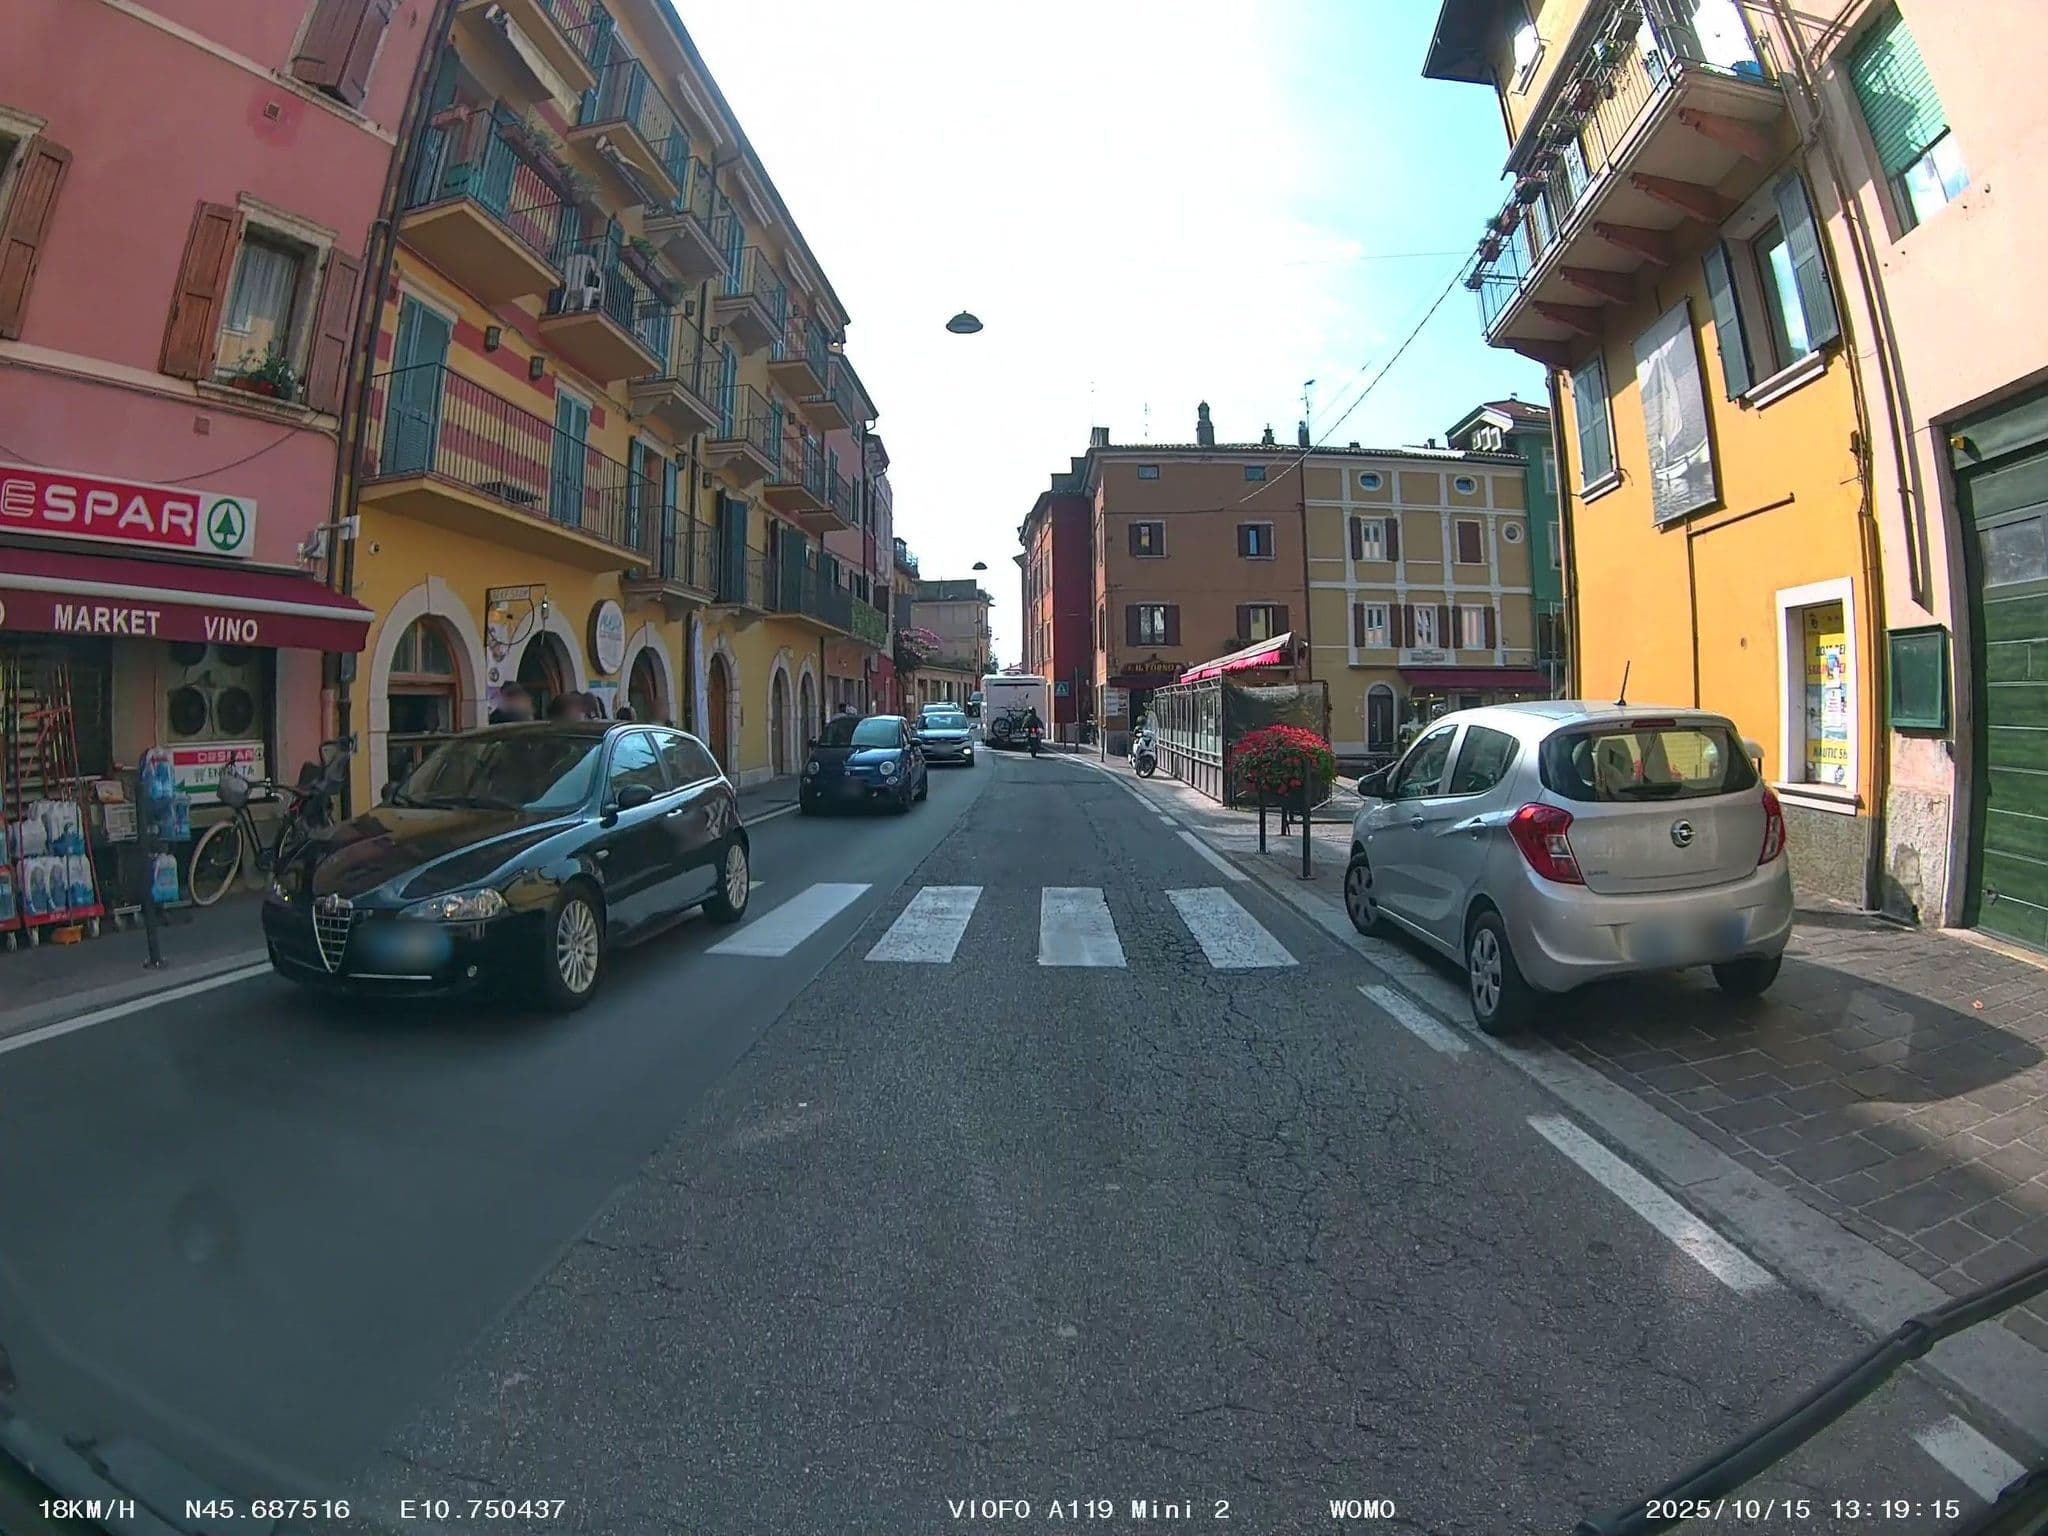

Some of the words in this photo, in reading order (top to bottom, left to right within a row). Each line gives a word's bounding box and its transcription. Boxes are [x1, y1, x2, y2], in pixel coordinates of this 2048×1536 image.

[1, 479, 194, 537] ESPAR
[54, 604, 161, 636] MARKET
[204, 615, 259, 642] VINO
